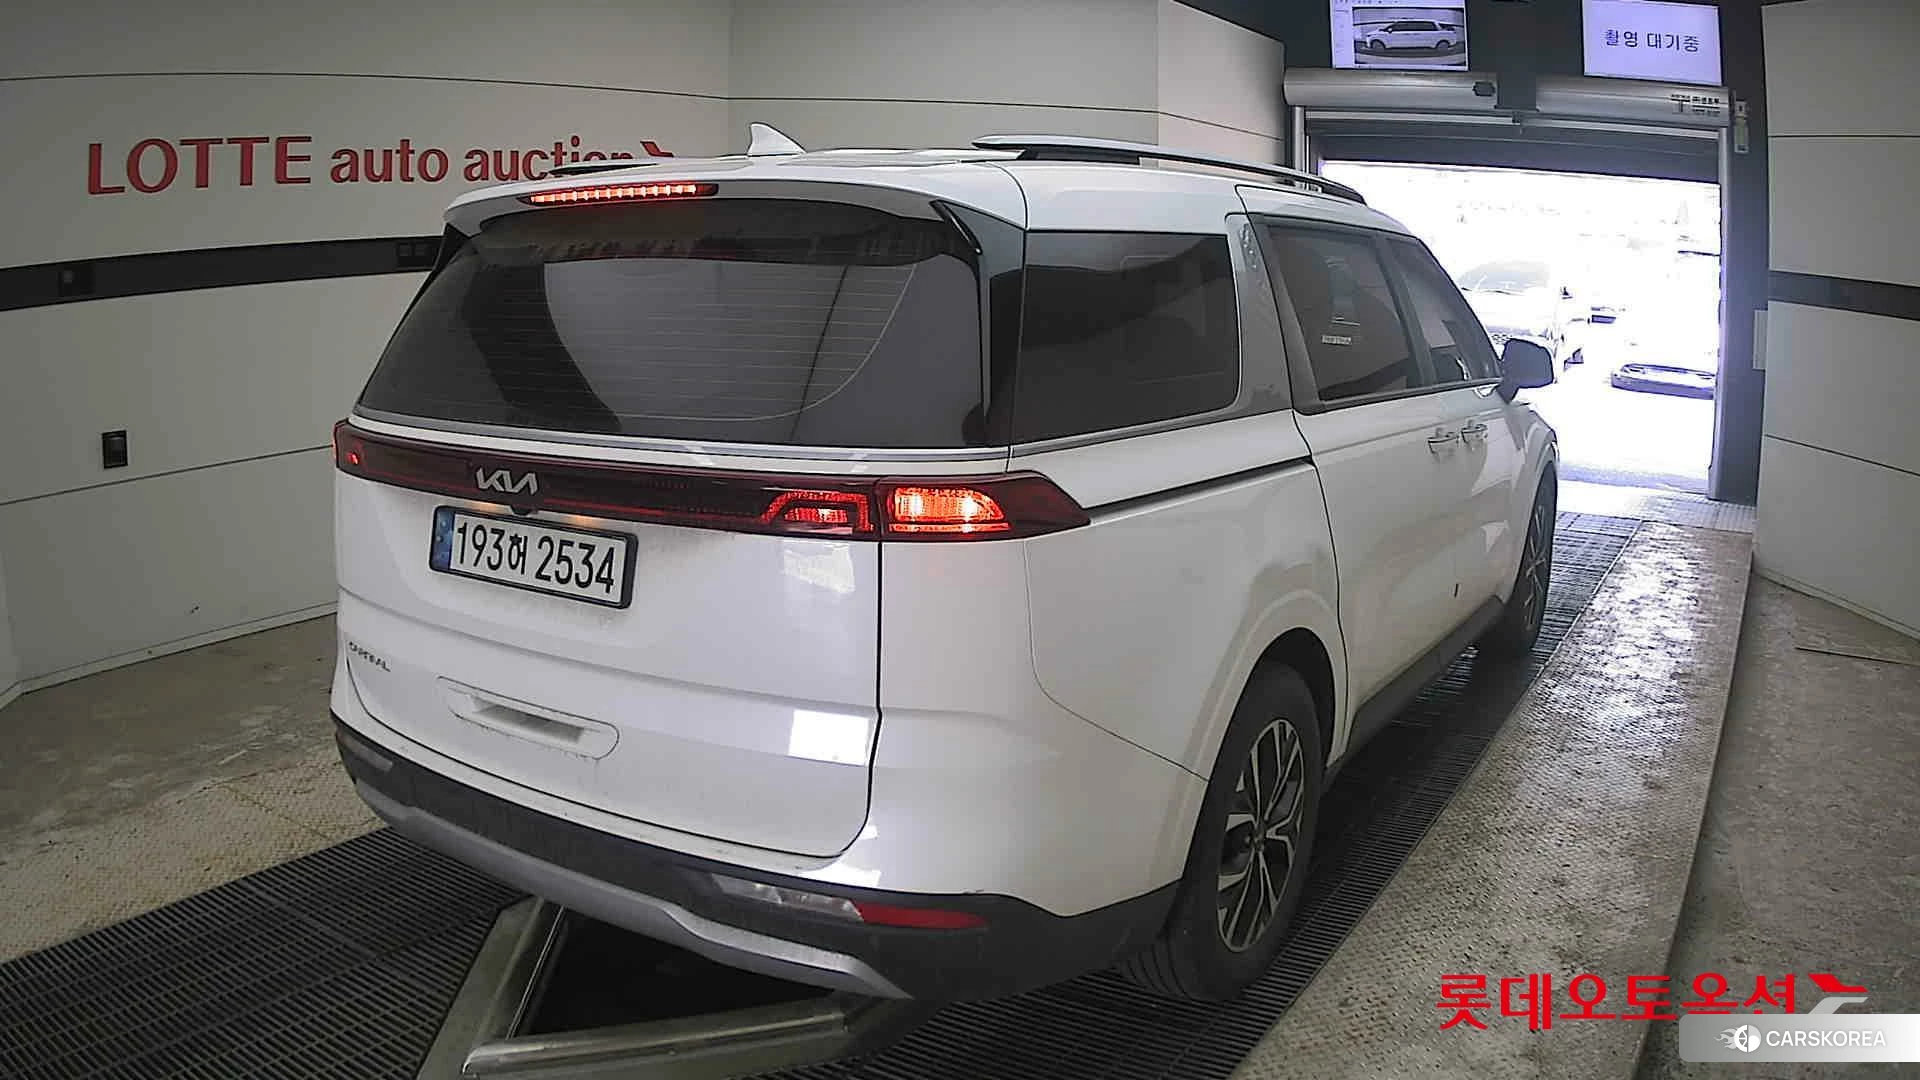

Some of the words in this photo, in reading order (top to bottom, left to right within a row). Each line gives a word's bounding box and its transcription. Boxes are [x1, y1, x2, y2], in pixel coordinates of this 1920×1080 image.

[1646, 32, 1700, 52] 대기중
[87, 136, 312, 195] LOTTE
[329, 138, 448, 184] auto
[475, 467, 538, 496] KIA
[457, 521, 528, 575] 193허
[534, 535, 615, 594] 2534
